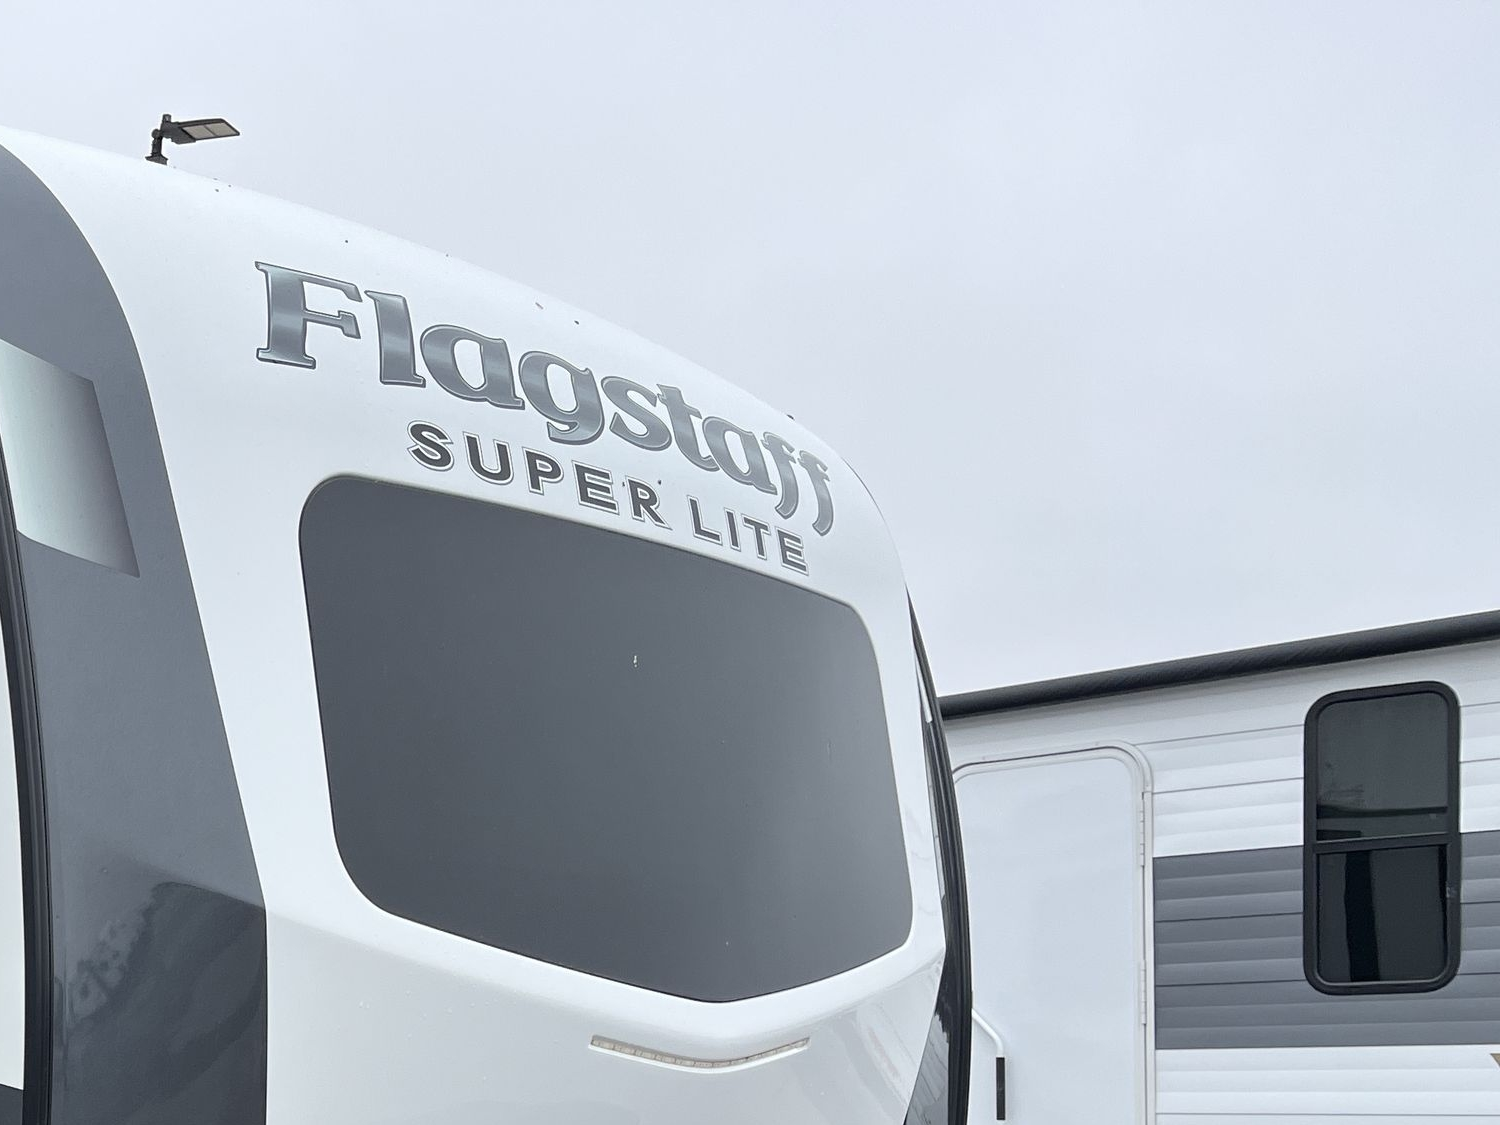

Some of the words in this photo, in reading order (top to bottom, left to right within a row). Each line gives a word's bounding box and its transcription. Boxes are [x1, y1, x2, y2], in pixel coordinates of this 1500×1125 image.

[254, 261, 834, 536] Flagstaff
[408, 421, 671, 530] SUPER
[687, 495, 809, 576] LITE
